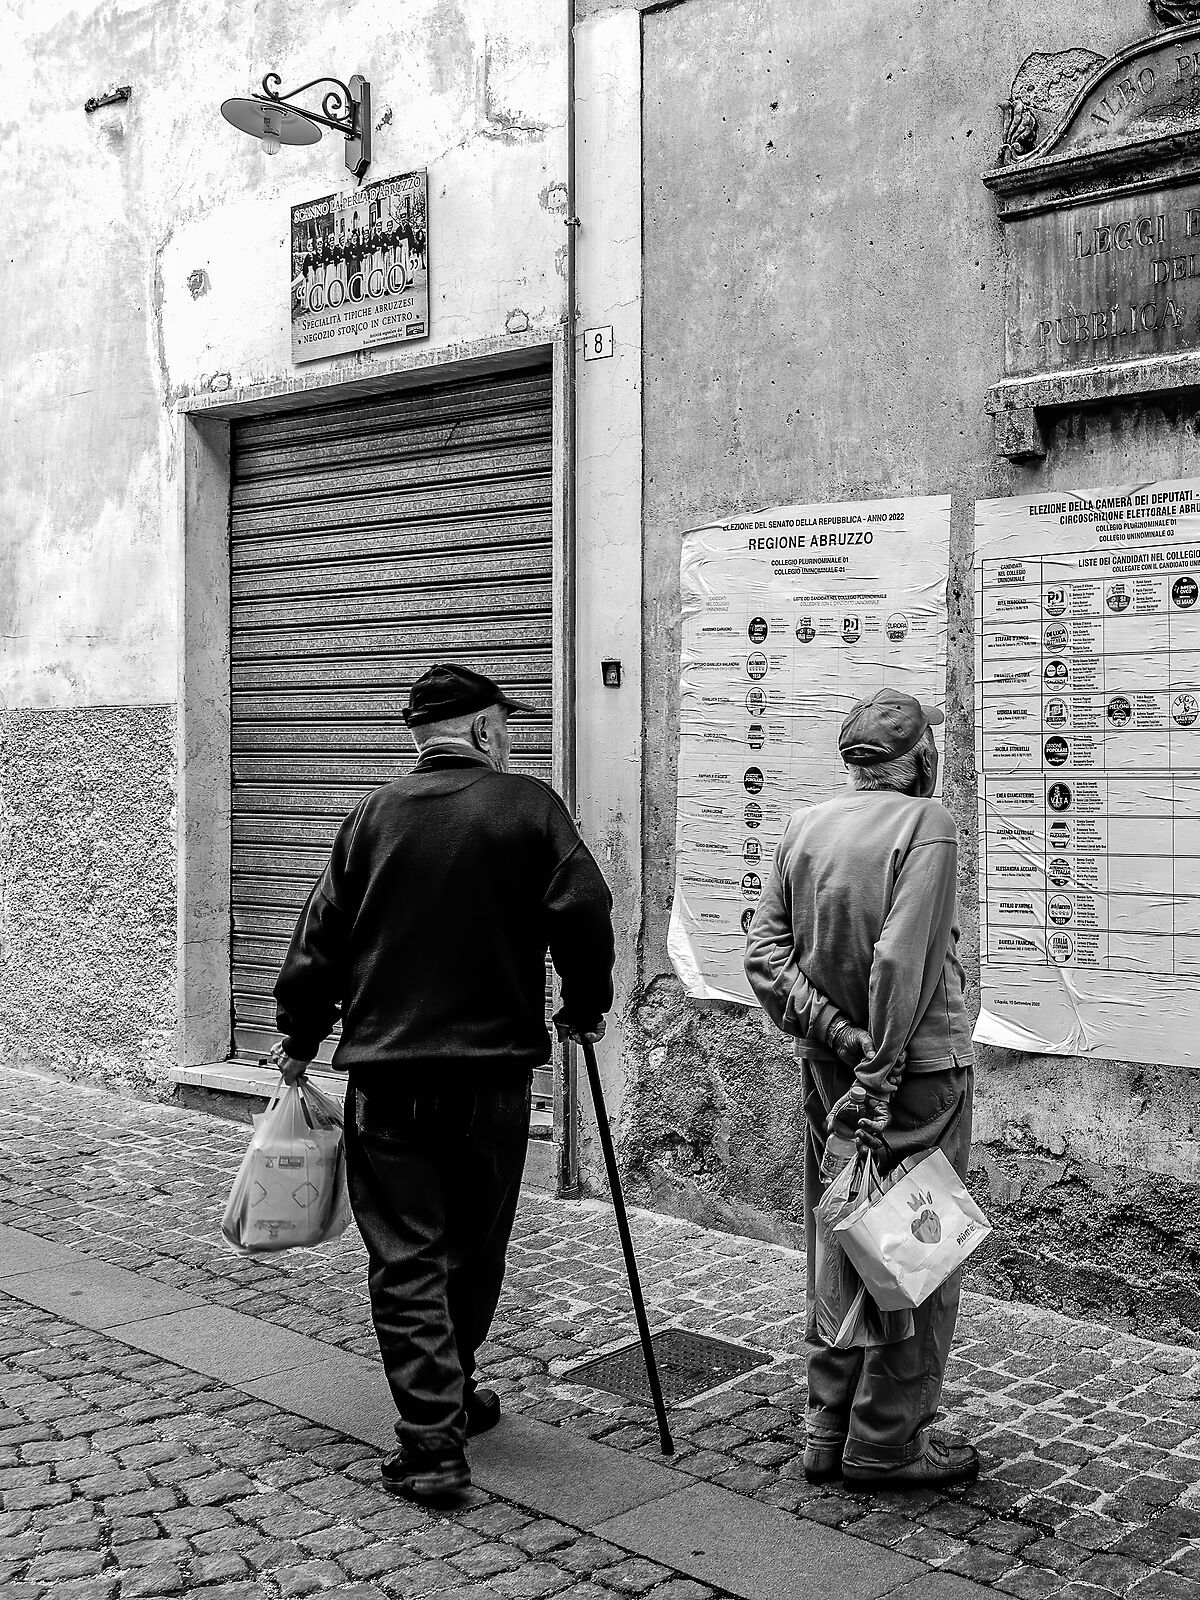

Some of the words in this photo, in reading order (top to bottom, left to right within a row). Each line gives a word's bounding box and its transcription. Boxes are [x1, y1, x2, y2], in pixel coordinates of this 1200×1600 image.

[1090, 68, 1155, 125] ALBO
[293, 201, 330, 223] SCANNO
[330, 198, 341, 213] LA
[342, 191, 368, 210] PERLA
[1074, 213, 1166, 260] LEGGI
[300, 313, 341, 330] SPECIALITÀ
[343, 307, 372, 321] TIPICHE
[374, 297, 414, 314] ABRUZZESI
[1037, 296, 1182, 346] PUBBLICA
[303, 329, 335, 343] NEGOZIO
[337, 321, 368, 336] STORICO
[371, 318, 379, 328] IN
[381, 311, 412, 325] CENTRO
[595, 333, 603, 354] 8
[1029, 503, 1066, 516] ELEZIONE
[1068, 501, 1093, 512] DELLA
[1095, 498, 1132, 510] CAMERA
[1134, 495, 1149, 506] DEI
[1151, 489, 1193, 504] DEPUTATI
[754, 521, 767, 529] DEL
[768, 519, 794, 528] SENATO
[795, 518, 817, 526] DELLA
[818, 515, 862, 525] REPUBBLICA
[866, 513, 887, 522] ANNO
[888, 512, 904, 521] 2022
[1059, 511, 1124, 525] CIRCOSCRIZIONE
[1126, 505, 1176, 519] ELETTORALE
[1095, 523, 1122, 532] COLLEGIO
[1098, 533, 1125, 542] COLLEGIO
[1126, 529, 1165, 540] UNINOMINALE
[748, 536, 806, 550] REGIONE
[809, 531, 873, 547] ABRUZZO
[770, 558, 798, 566] COLLEGIO
[1078, 558, 1097, 567] LISTE
[1099, 556, 1110, 566] DEI
[1112, 553, 1149, 565] CANDIDATI
[1150, 552, 1164, 562] NEL
[1166, 549, 1200, 560] COLLEGIO
[1112, 564, 1140, 573] COLLEGATE
[1158, 560, 1188, 569] CANDIDATO
